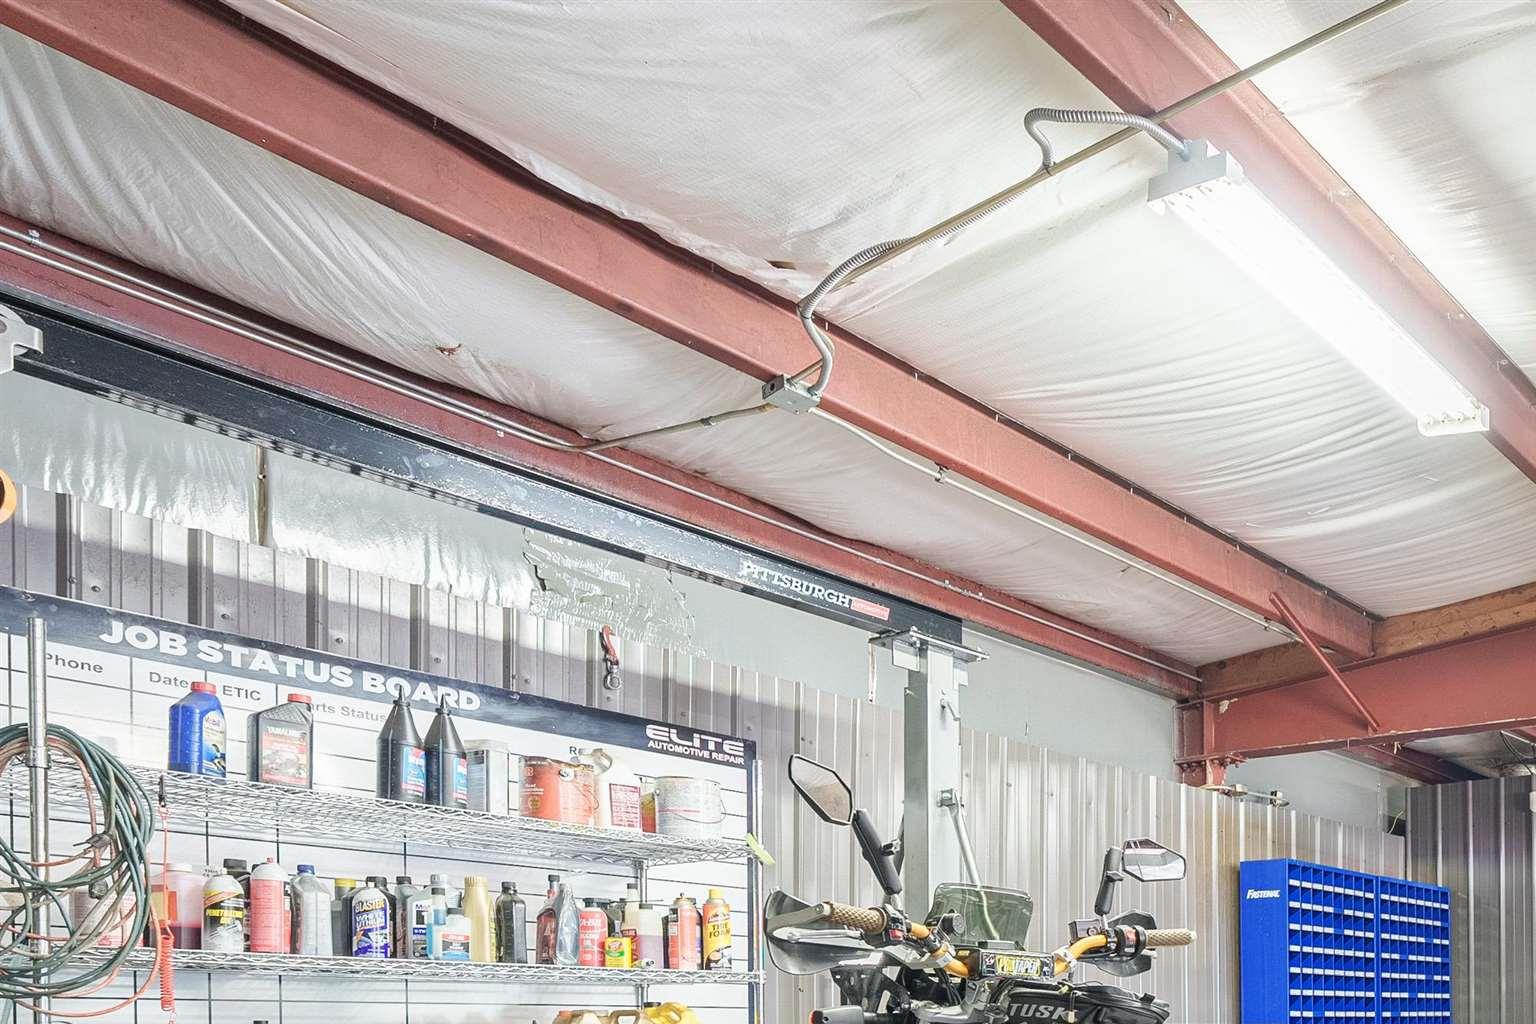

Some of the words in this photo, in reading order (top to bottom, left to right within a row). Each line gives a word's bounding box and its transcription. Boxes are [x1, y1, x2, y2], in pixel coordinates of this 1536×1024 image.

[741, 561, 851, 609] PITTSBURGH
[99, 620, 188, 656] JOB
[196, 638, 354, 688] STATUS
[362, 670, 481, 711] BOARD
[149, 671, 189, 690] Date
[222, 685, 261, 701] ETIC
[340, 705, 386, 723] Status
[645, 724, 745, 756] ELITE
[647, 739, 709, 760] AUTOMOTIVE
[711, 750, 745, 765] REPAIR
[1009, 1003, 1067, 1020] TUSK
